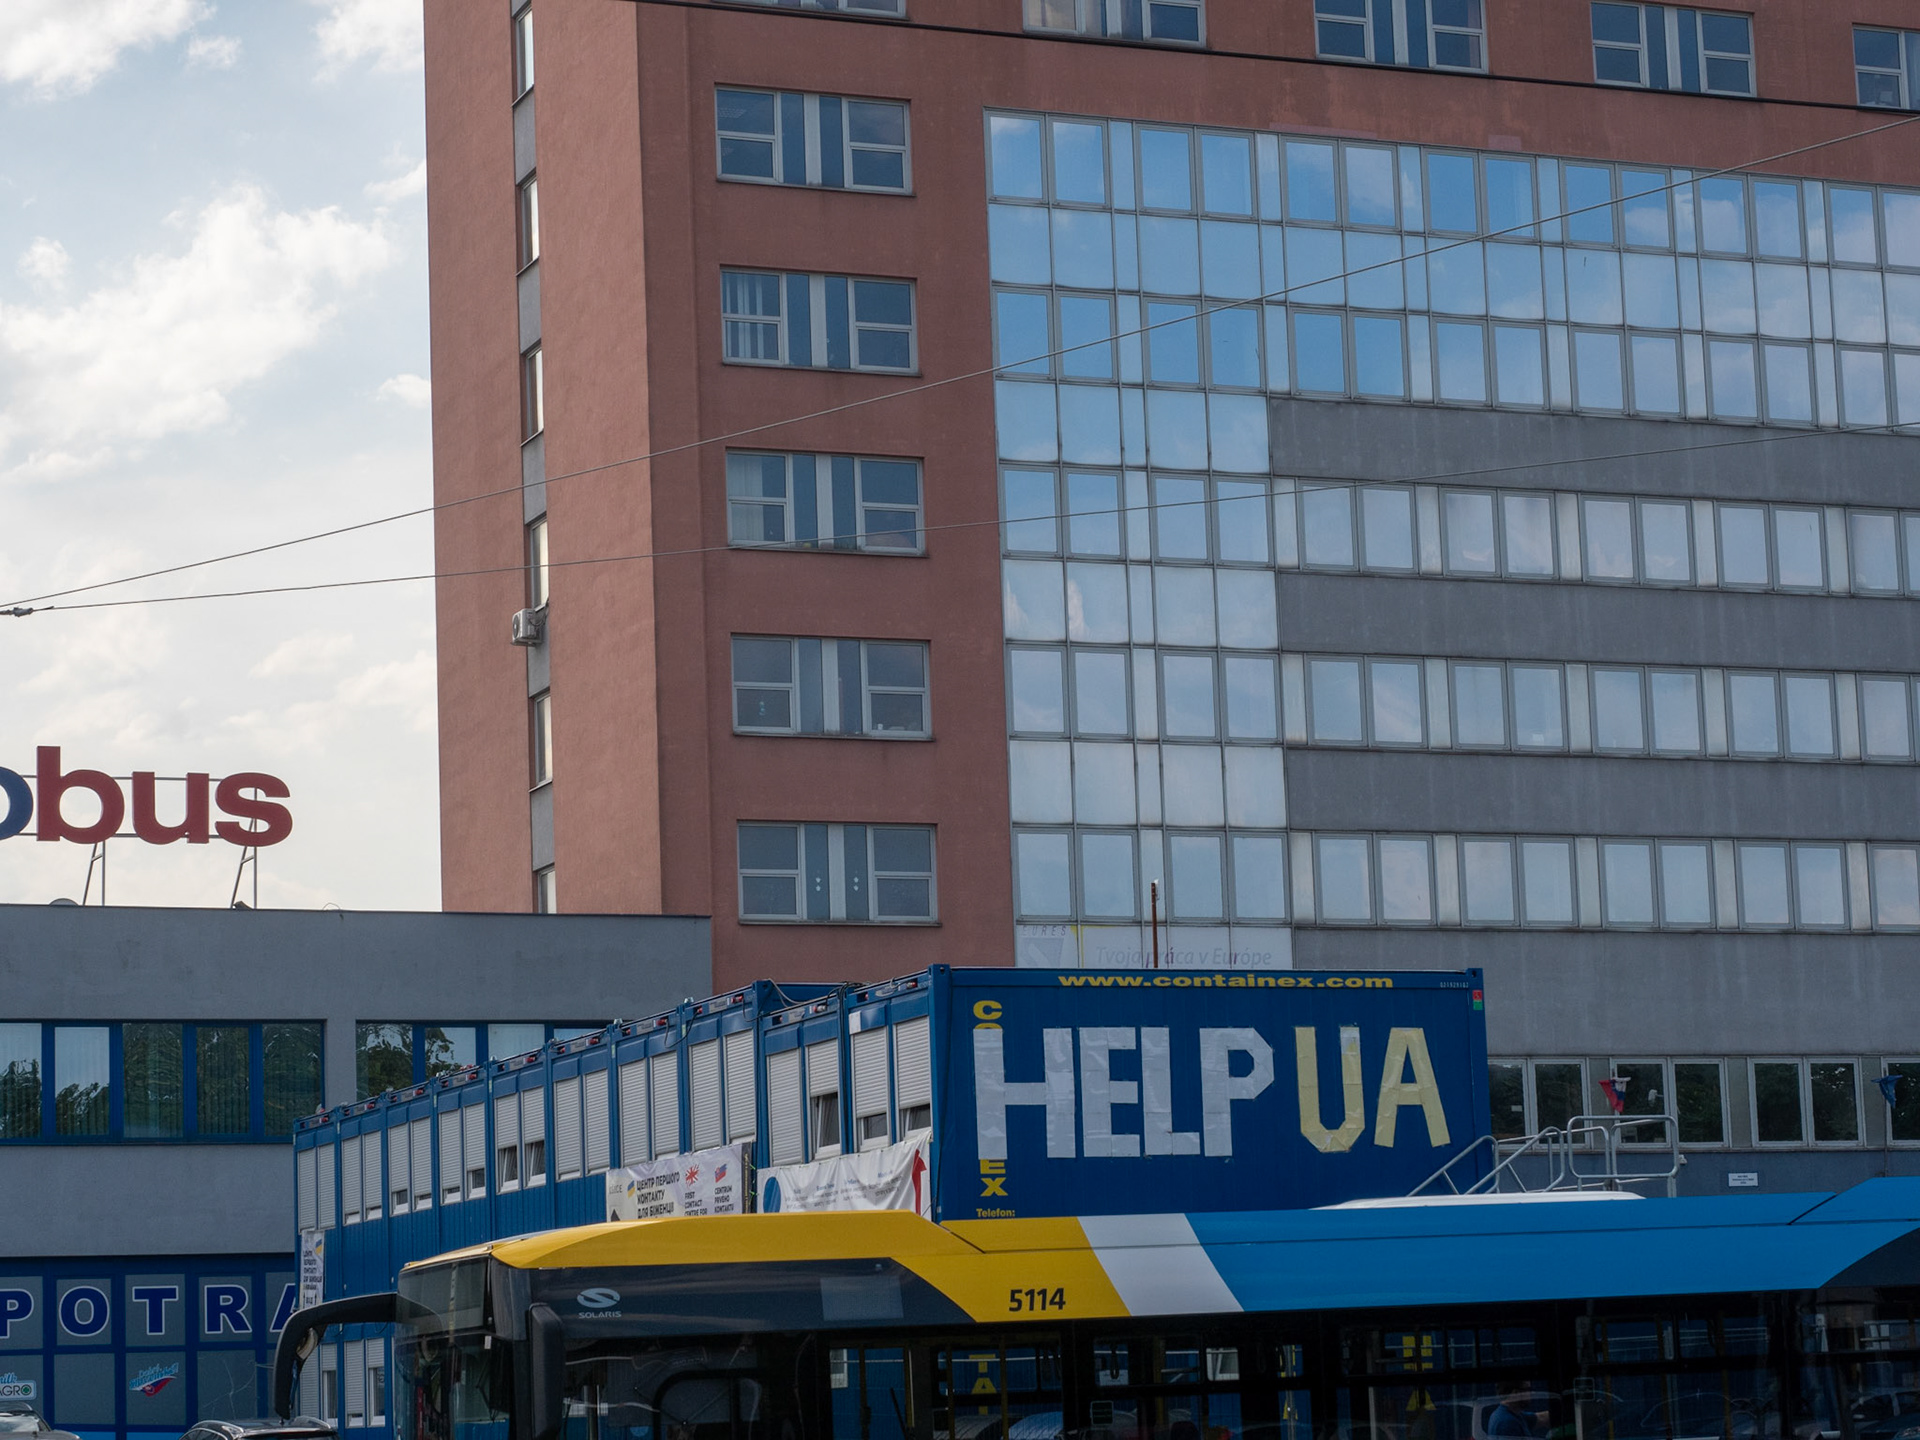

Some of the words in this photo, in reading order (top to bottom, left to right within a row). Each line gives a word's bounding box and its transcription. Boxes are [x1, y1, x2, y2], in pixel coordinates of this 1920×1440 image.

[1096, 947, 1141, 968] Tvoja
[1200, 952, 1209, 964] v
[1212, 947, 1272, 968] Európe
[1057, 974, 1394, 988] www.containex.com
[973, 1026, 1274, 1160] HELP
[1295, 1026, 1451, 1153] UA
[975, 1208, 1016, 1218] Telefon:
[1008, 1287, 1066, 1312] 5114
[579, 1310, 622, 1319] SOLARIS
